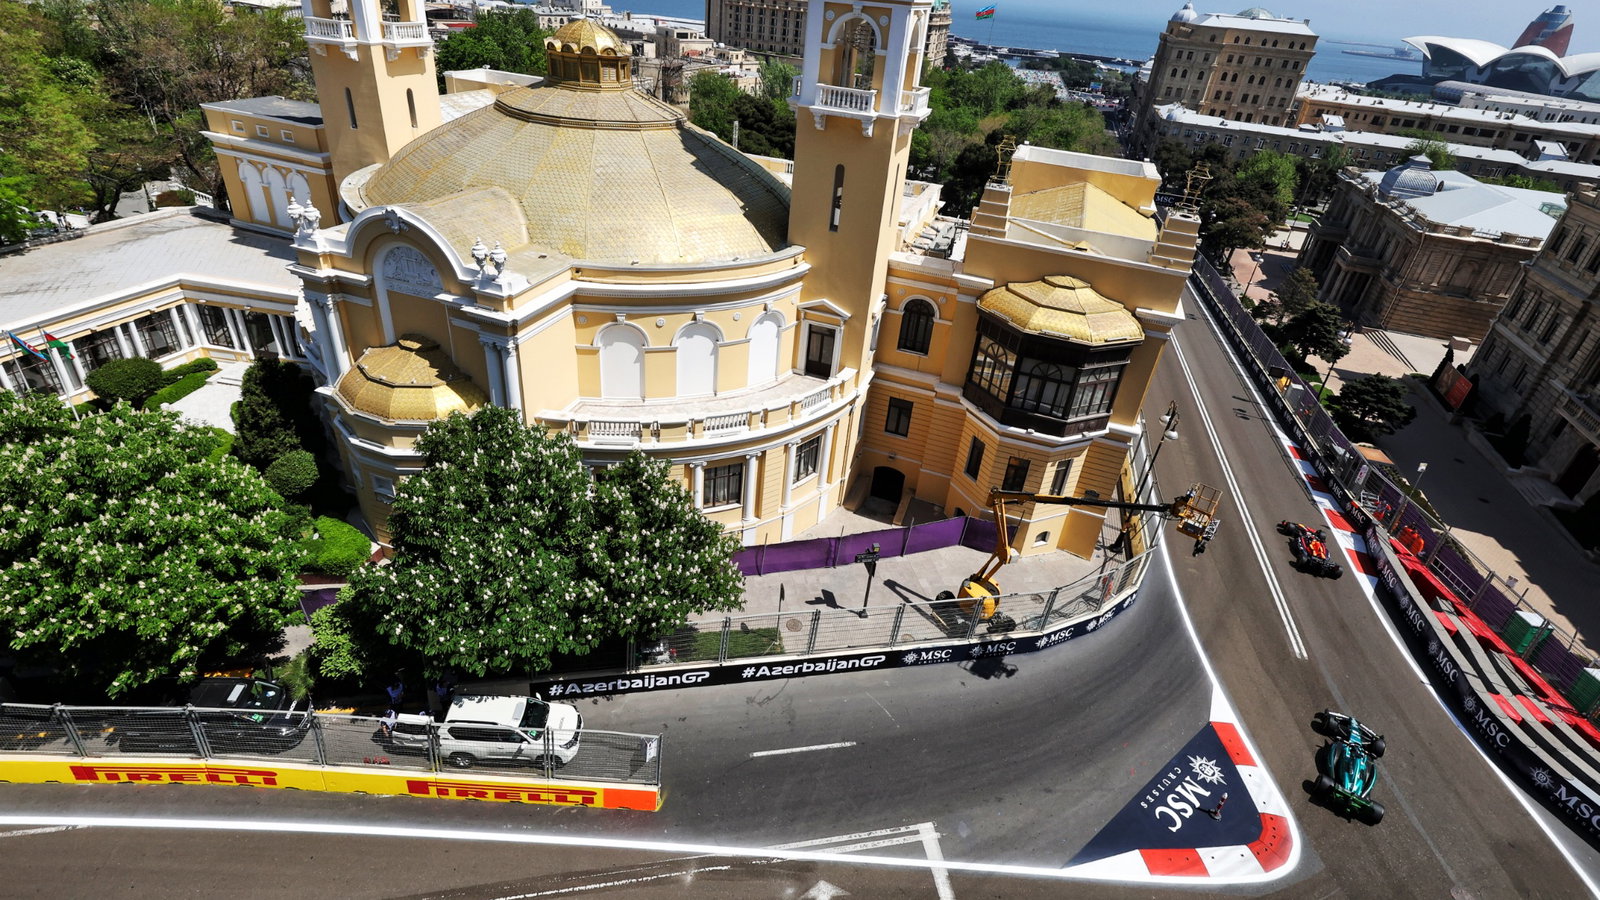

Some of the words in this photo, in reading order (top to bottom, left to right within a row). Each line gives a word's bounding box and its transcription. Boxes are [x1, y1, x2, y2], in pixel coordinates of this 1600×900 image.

[1382, 564, 1397, 588] MSC
[1407, 605, 1425, 631] MSC
[985, 641, 1016, 653] MSC
[1049, 628, 1074, 642] MSC
[742, 655, 886, 678] #AzerbaijanGP
[920, 649, 952, 660] MSC
[1437, 651, 1459, 682] MSC
[549, 671, 710, 696] #AzerbaijanGP
[1475, 708, 1510, 748] MSC
[69, 766, 277, 785] PIRELLI
[1140, 767, 1181, 808] CRUISES
[406, 780, 597, 805] PIRELLI
[1155, 775, 1211, 832] MSC
